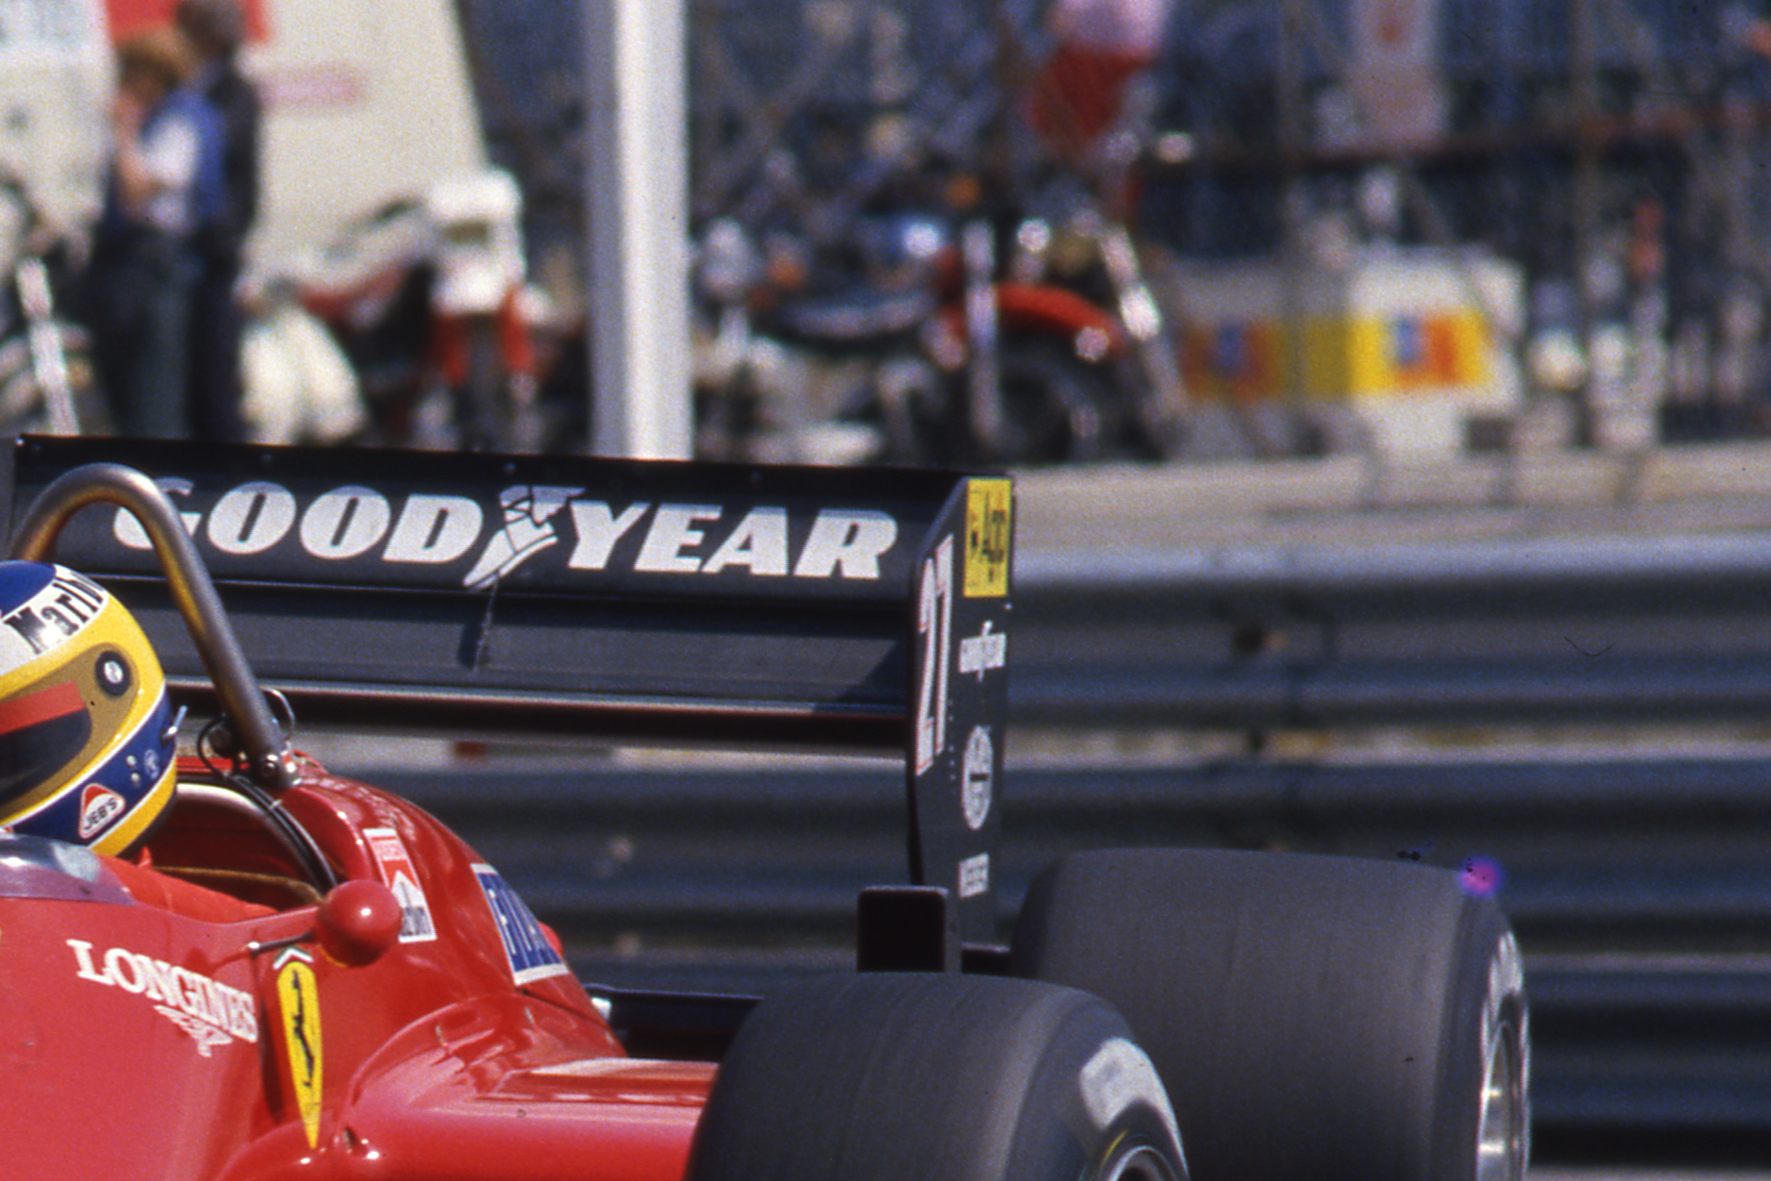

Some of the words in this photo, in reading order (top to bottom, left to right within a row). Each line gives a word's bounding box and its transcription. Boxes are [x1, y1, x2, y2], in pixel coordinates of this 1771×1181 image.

[113, 477, 897, 580] GOODYEAR
[82, 797, 118, 831] JEB'S
[66, 938, 258, 1043] LONGINES
